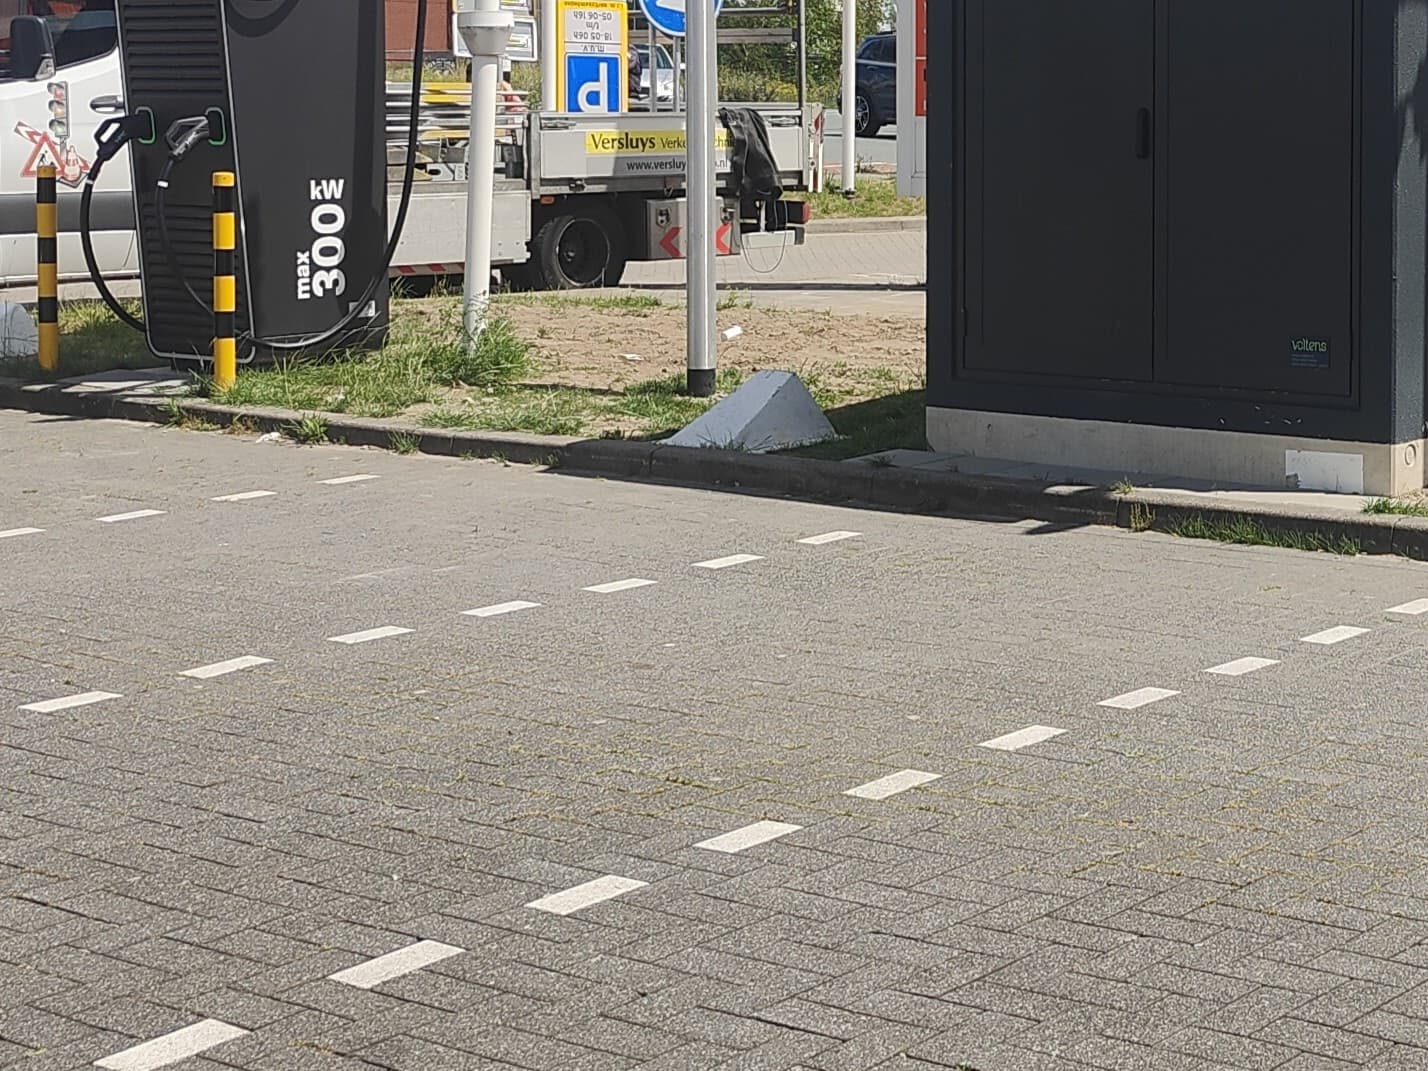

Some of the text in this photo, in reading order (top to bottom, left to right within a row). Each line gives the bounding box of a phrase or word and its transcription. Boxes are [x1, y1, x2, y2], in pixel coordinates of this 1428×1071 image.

[590, 132, 656, 152] Versluys
[309, 178, 344, 200] kW
[296, 203, 346, 300] max 300
